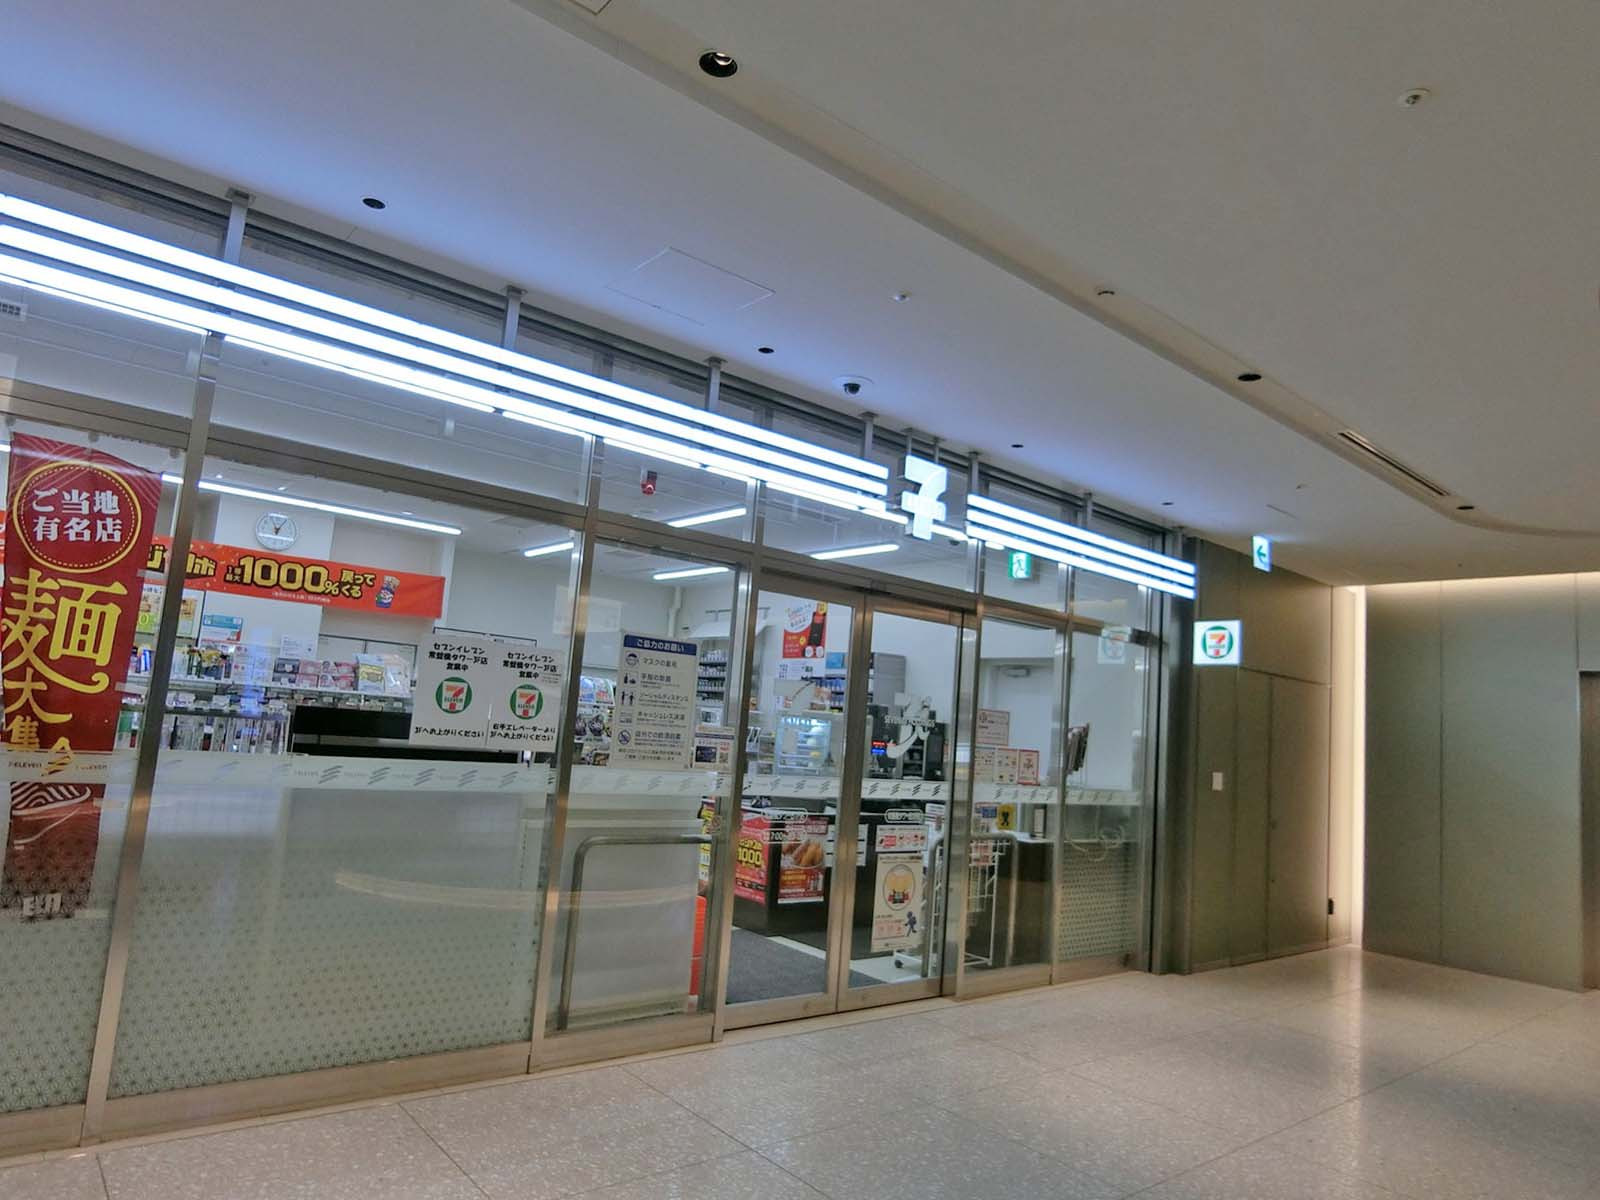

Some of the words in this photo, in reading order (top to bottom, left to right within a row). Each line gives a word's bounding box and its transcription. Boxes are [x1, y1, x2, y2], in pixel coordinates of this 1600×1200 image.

[31, 487, 121, 515] ご当地
[33, 516, 123, 543] 有名店
[340, 569, 376, 587] 戻って
[341, 583, 363, 599] くる
